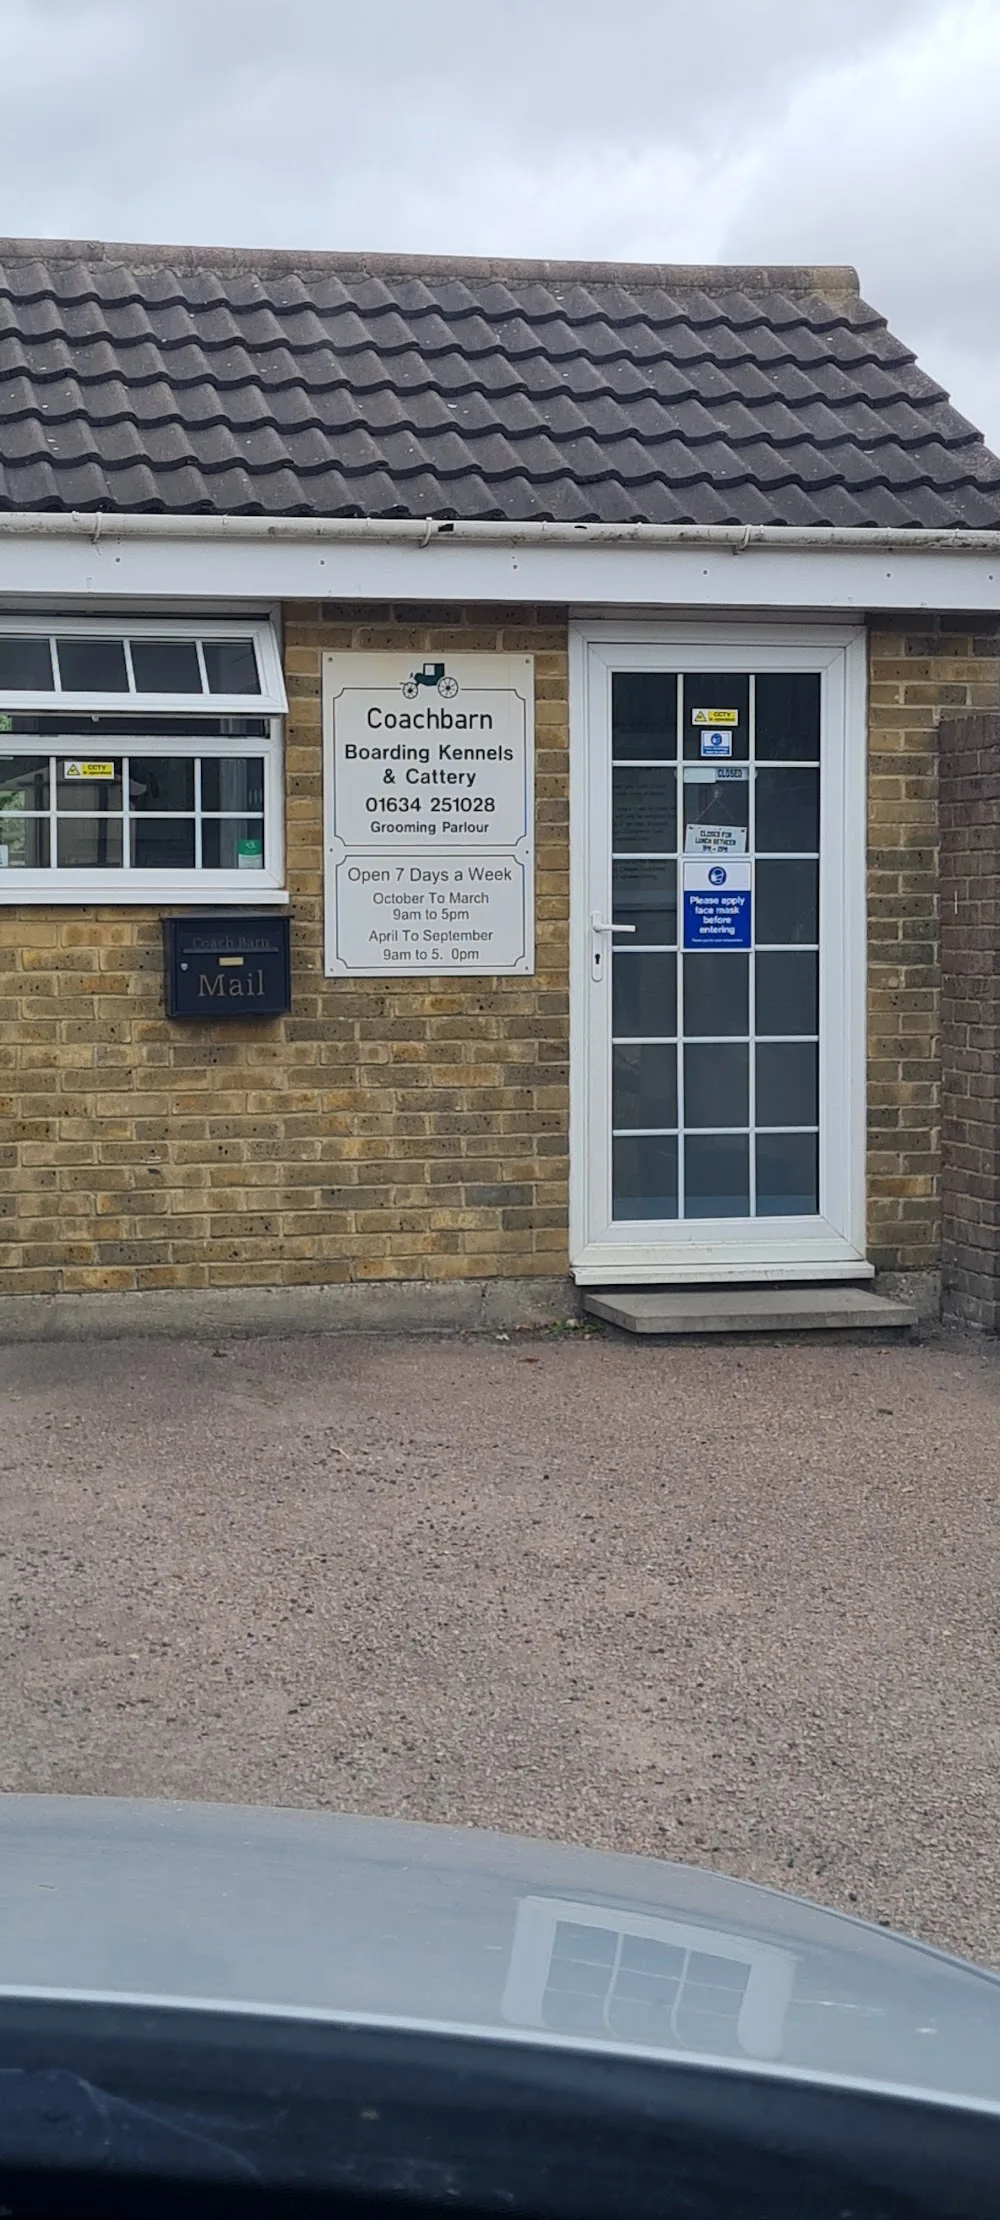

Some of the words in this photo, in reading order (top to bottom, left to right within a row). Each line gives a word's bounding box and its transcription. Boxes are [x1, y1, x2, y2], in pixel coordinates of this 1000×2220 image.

[367, 707, 493, 730] Coachbarn
[345, 744, 430, 763] Boarding
[439, 744, 514, 761] Kennels
[382, 770, 396, 785] &
[405, 769, 476, 788] Cattery
[718, 768, 742, 778] CLOSED
[366, 797, 422, 812] 01634
[430, 797, 496, 812] 251028
[370, 822, 436, 836] Grooming
[442, 821, 490, 834] Parlour
[700, 830, 720, 838] CLOSED
[713, 838, 736, 846] BETWEEN
[348, 867, 390, 884] Open
[396, 868, 404, 881] 7
[410, 868, 449, 885] Days
[454, 870, 463, 882] a
[468, 867, 512, 881] Week
[373, 892, 425, 904] October
[428, 892, 445, 904] To
[449, 892, 489, 904] March
[689, 896, 719, 905] Please
[721, 896, 745, 906] apply
[393, 909, 421, 920] 9am
[425, 909, 437, 920] to
[441, 908, 469, 922] 5pm
[695, 906, 714, 914] face
[716, 906, 740, 914] mask
[703, 916, 732, 924] before
[699, 926, 736, 935] entering
[192, 936, 233, 948] Coach
[239, 937, 269, 948] Barn
[368, 930, 398, 944] April
[402, 930, 419, 941] To
[423, 930, 494, 944] September
[383, 948, 411, 960] 9am
[415, 949, 428, 960] to
[198, 969, 265, 997] Mail
